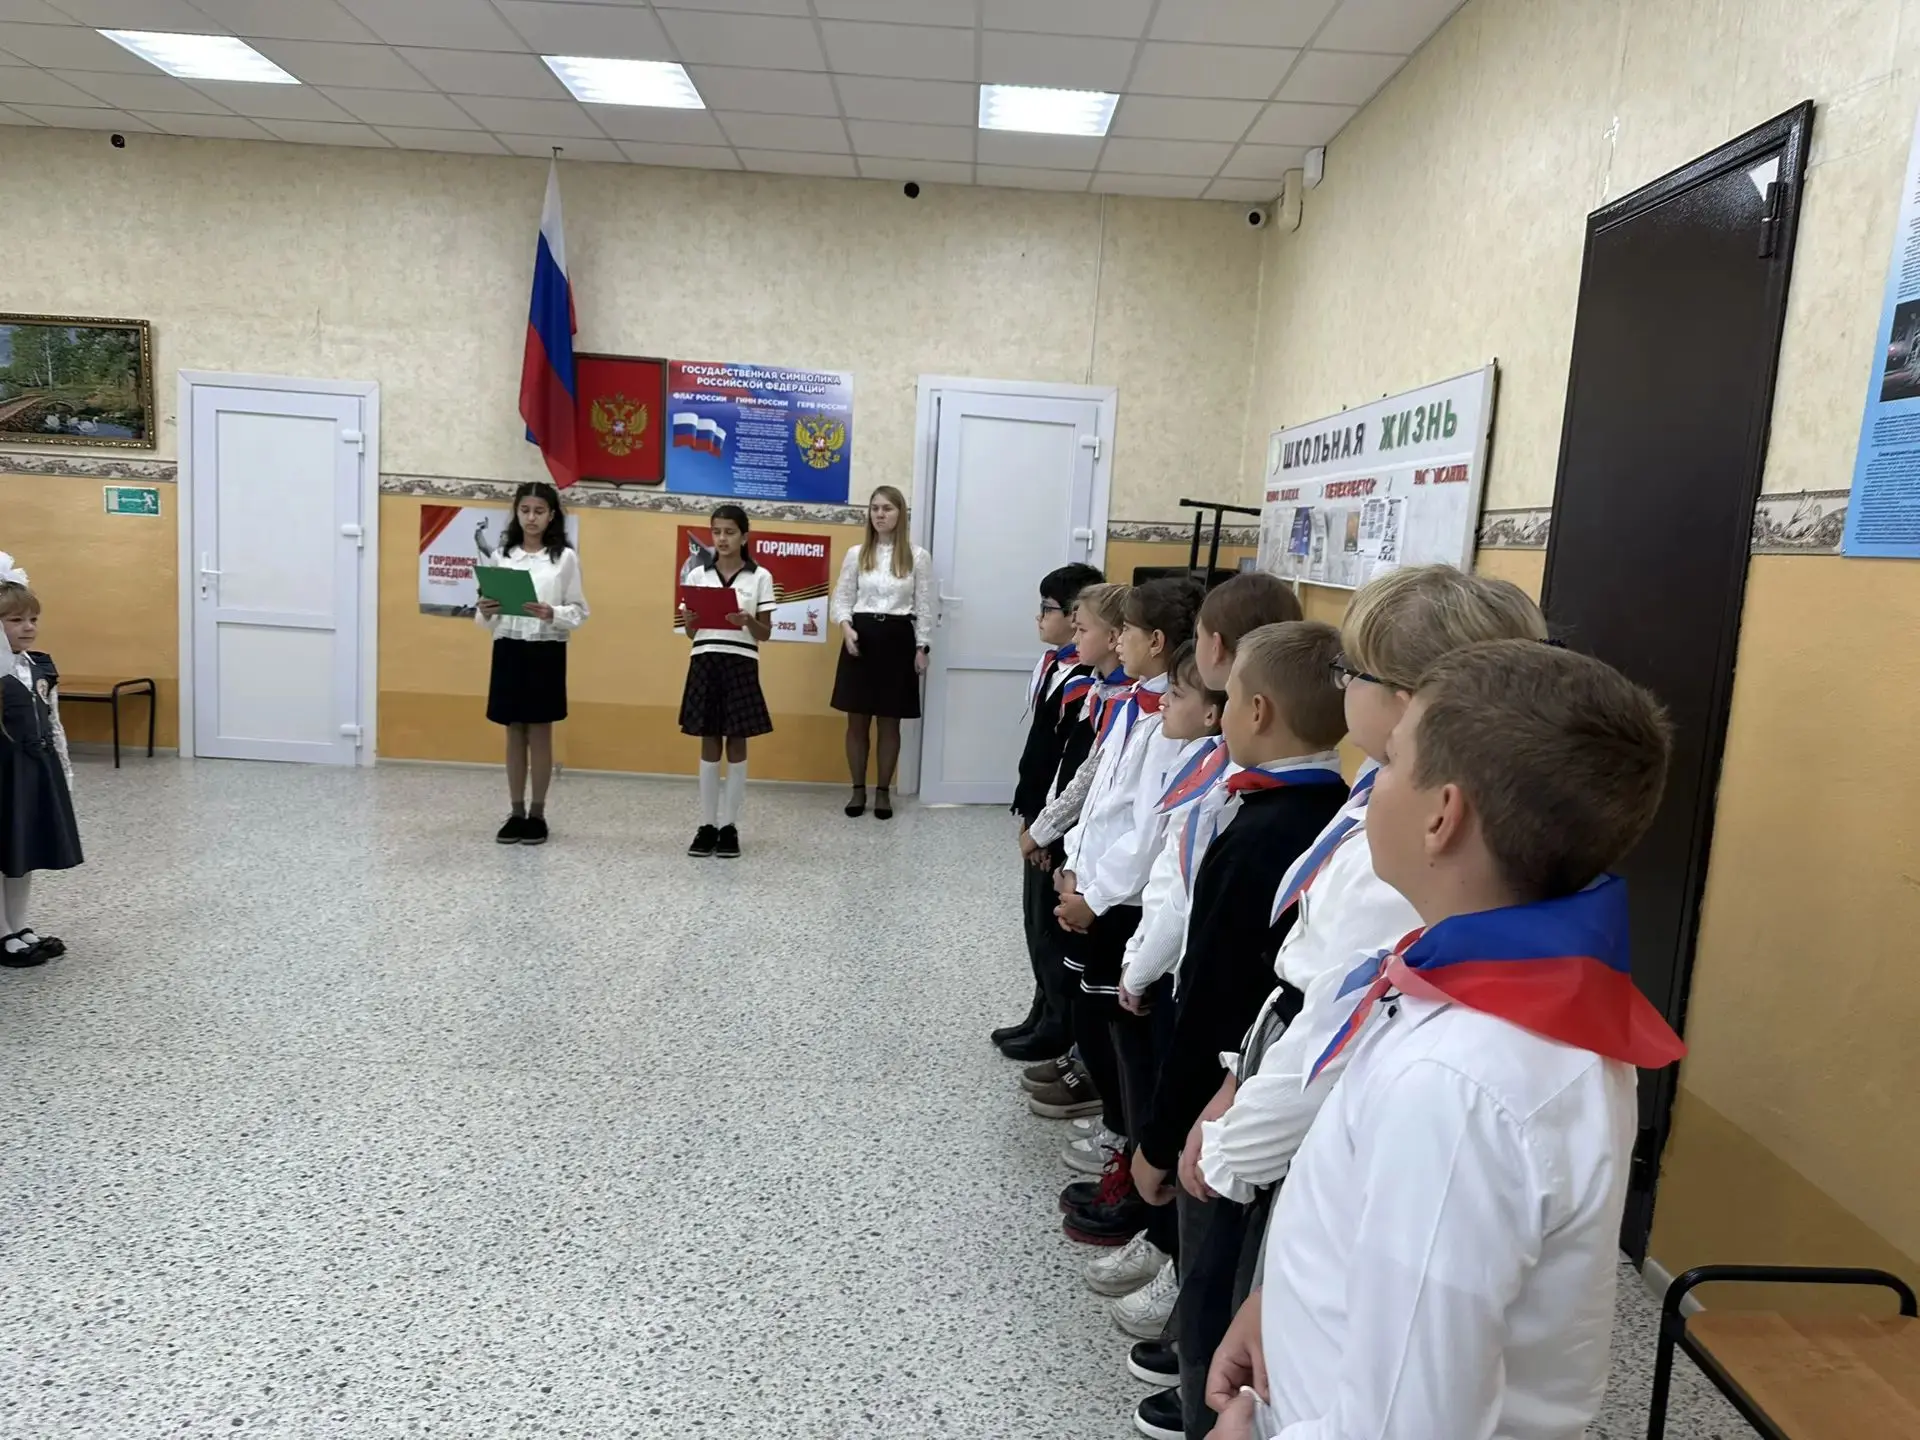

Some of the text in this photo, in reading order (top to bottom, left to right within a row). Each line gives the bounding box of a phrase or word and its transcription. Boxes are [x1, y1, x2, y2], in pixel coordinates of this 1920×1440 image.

[681, 365, 841, 384] ГОСУДАРСТВЕННАЯ СИМВОЛИКА
[697, 377, 825, 394] РОССИЙСКОЙ ФЕДЕРАЦИИ
[672, 391, 727, 402] ФЛАГ РОССИИ
[757, 398, 789, 407] РОССИИ
[1282, 398, 1458, 469] ШКОЛЬНАЯ ЖИЗНЬ
[756, 540, 824, 557] ГОРДИМСЯ!
[428, 555, 477, 566] ГОРДИМСЯ
[428, 567, 473, 579] ПОБЕДОЙ!
